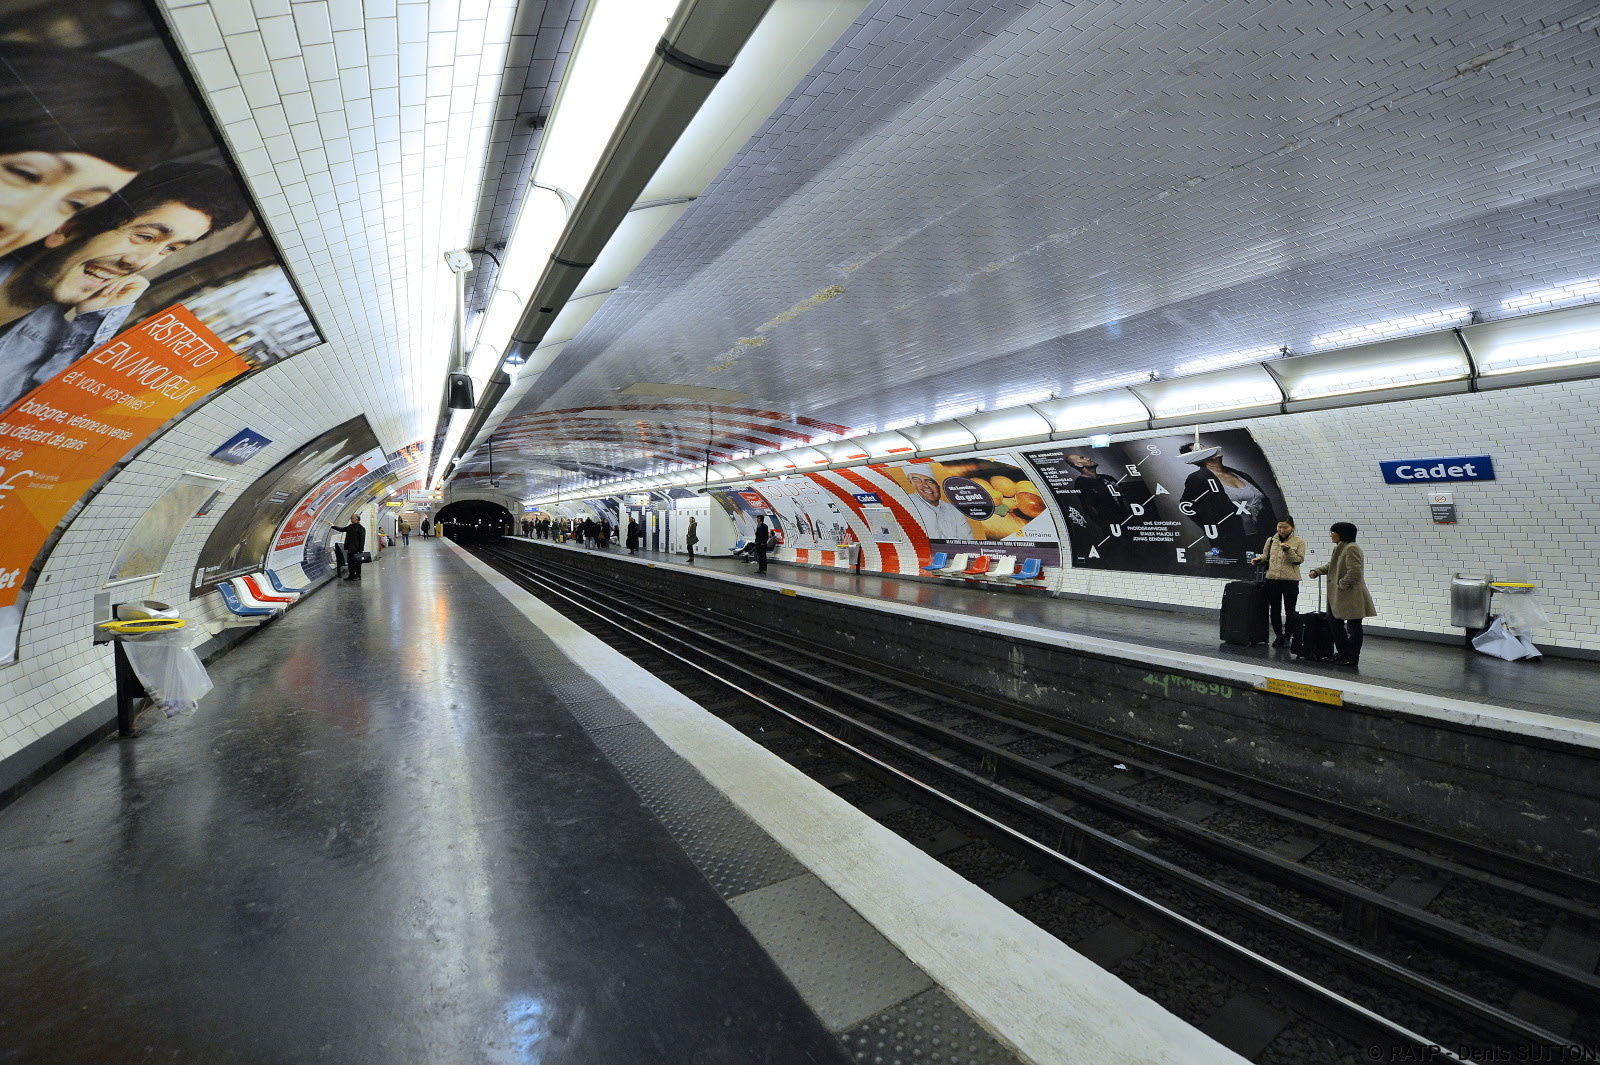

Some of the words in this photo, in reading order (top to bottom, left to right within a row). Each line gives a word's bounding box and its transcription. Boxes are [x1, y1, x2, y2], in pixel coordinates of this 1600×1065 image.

[141, 313, 219, 367] RISTRETTO
[92, 341, 140, 369] EN
[62, 371, 85, 384] et
[76, 377, 106, 396] vous,
[102, 387, 124, 401] vos
[117, 394, 147, 410] envies
[18, 398, 69, 424] bologne,
[66, 413, 100, 431] vérone
[96, 422, 112, 434] ou
[10, 424, 53, 441] départ
[48, 431, 65, 446] de
[57, 438, 88, 451] paris
[5, 448, 23, 460] de
[1395, 463, 1478, 480] Cadet
[759, 482, 820, 499] SOLDES
